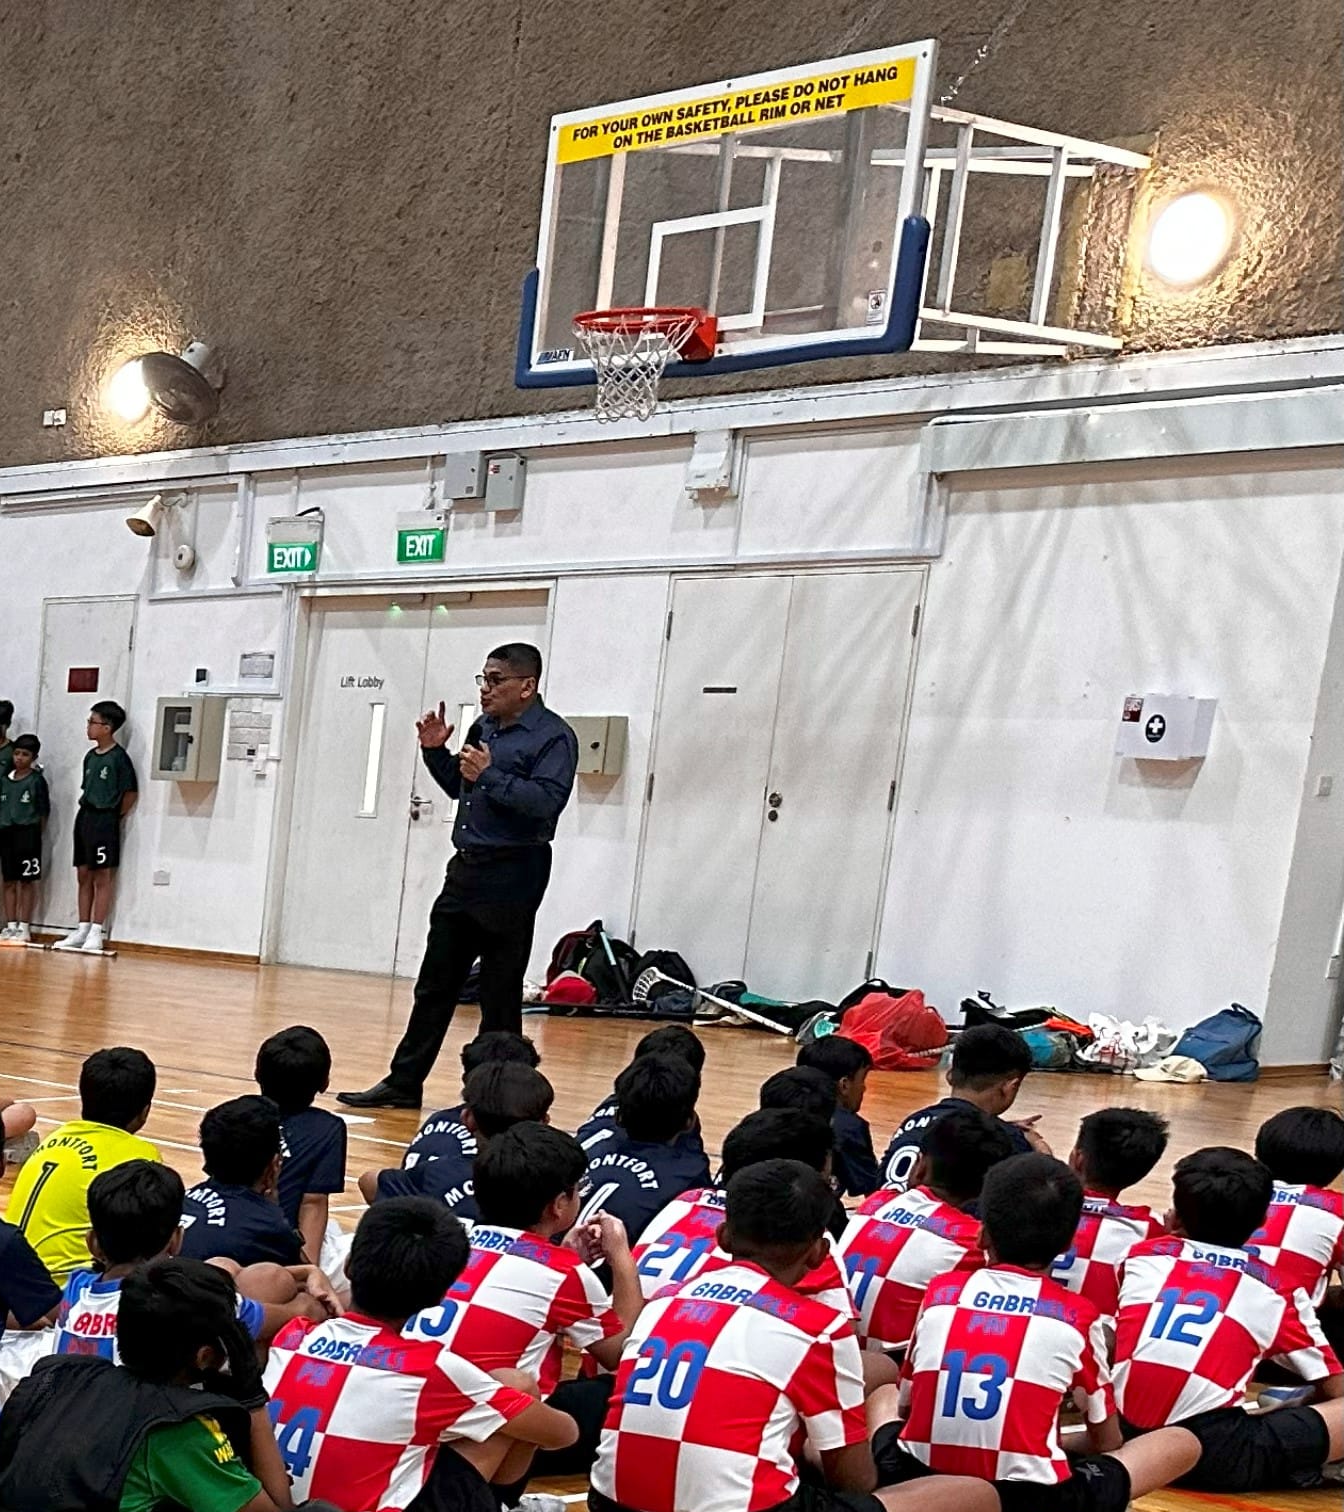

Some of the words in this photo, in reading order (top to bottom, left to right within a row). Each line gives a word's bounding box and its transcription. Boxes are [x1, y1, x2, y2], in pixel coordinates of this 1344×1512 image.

[573, 125, 598, 141] FOR
[602, 117, 638, 136] YOUR
[642, 111, 672, 126] OWN
[676, 100, 732, 120] SAFETY,
[735, 90, 790, 108] PLEASE
[793, 83, 813, 98] DO
[819, 77, 851, 94] NOT
[854, 67, 898, 86] HANG
[613, 133, 634, 149] ON
[638, 128, 663, 144] THE
[667, 111, 756, 138] BASKETBALL
[760, 105, 786, 121] RIM
[790, 101, 811, 116] OR
[815, 94, 846, 111] NET
[273, 548, 302, 568] EXIT
[406, 534, 436, 557] EXIT
[340, 676, 355, 688] Lift
[357, 676, 384, 690] Lobby
[22, 858, 41, 876] 23
[96, 846, 107, 864] 5
[20, 1161, 59, 1234] 1
[638, 1232, 714, 1282] 21
[1150, 1287, 1221, 1347] 12
[624, 1335, 710, 1410] 20
[943, 1349, 1008, 1421] 13
